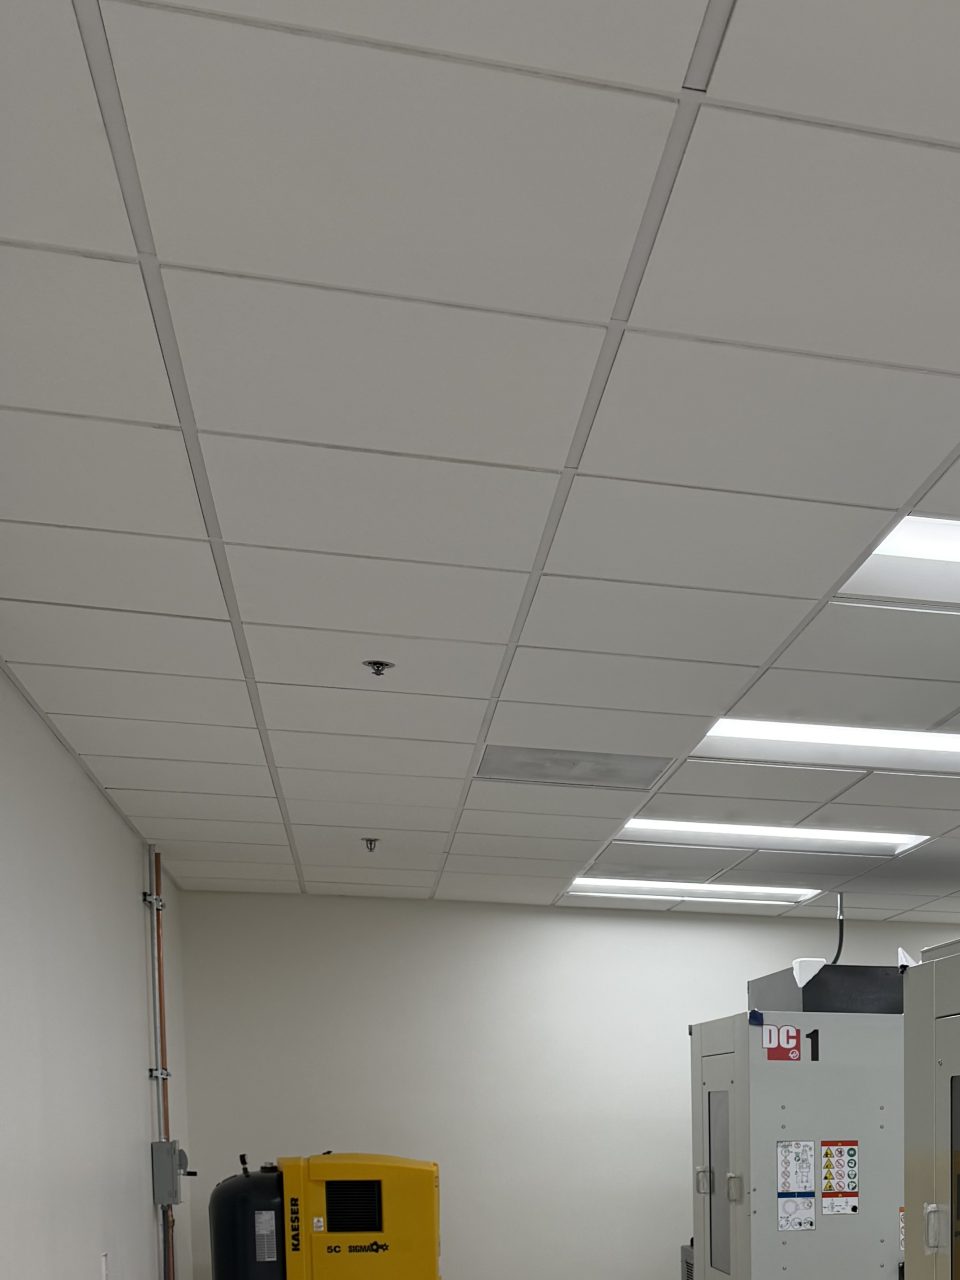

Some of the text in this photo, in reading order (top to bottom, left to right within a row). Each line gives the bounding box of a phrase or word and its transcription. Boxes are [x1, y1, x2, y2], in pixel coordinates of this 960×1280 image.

[762, 1024, 820, 1061] DC 1
[290, 1197, 300, 1252] KAESER
[326, 1245, 371, 1254] 5C SIGMA
